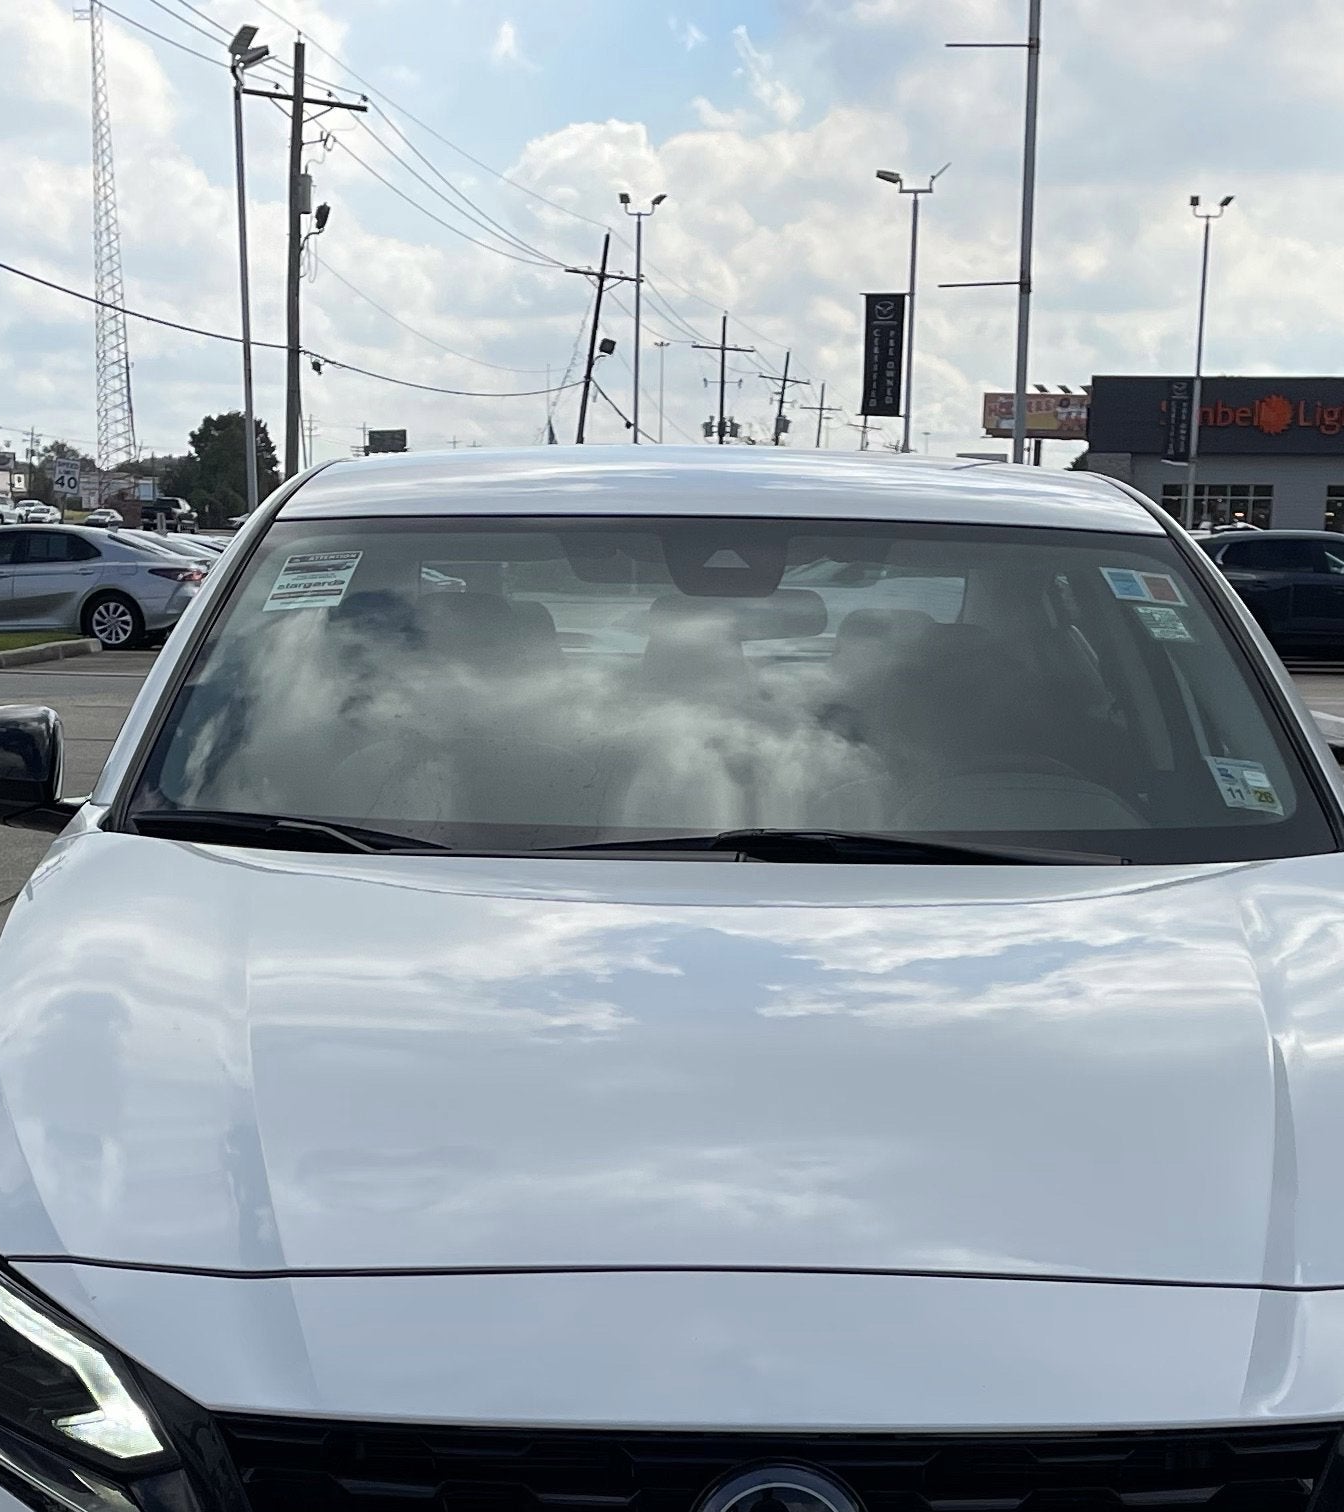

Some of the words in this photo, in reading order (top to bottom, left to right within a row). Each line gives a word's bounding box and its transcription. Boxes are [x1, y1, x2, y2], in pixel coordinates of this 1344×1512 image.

[55, 475, 77, 489] 40
[308, 553, 357, 561] ATTENTION
[1226, 787, 1246, 801] 11
